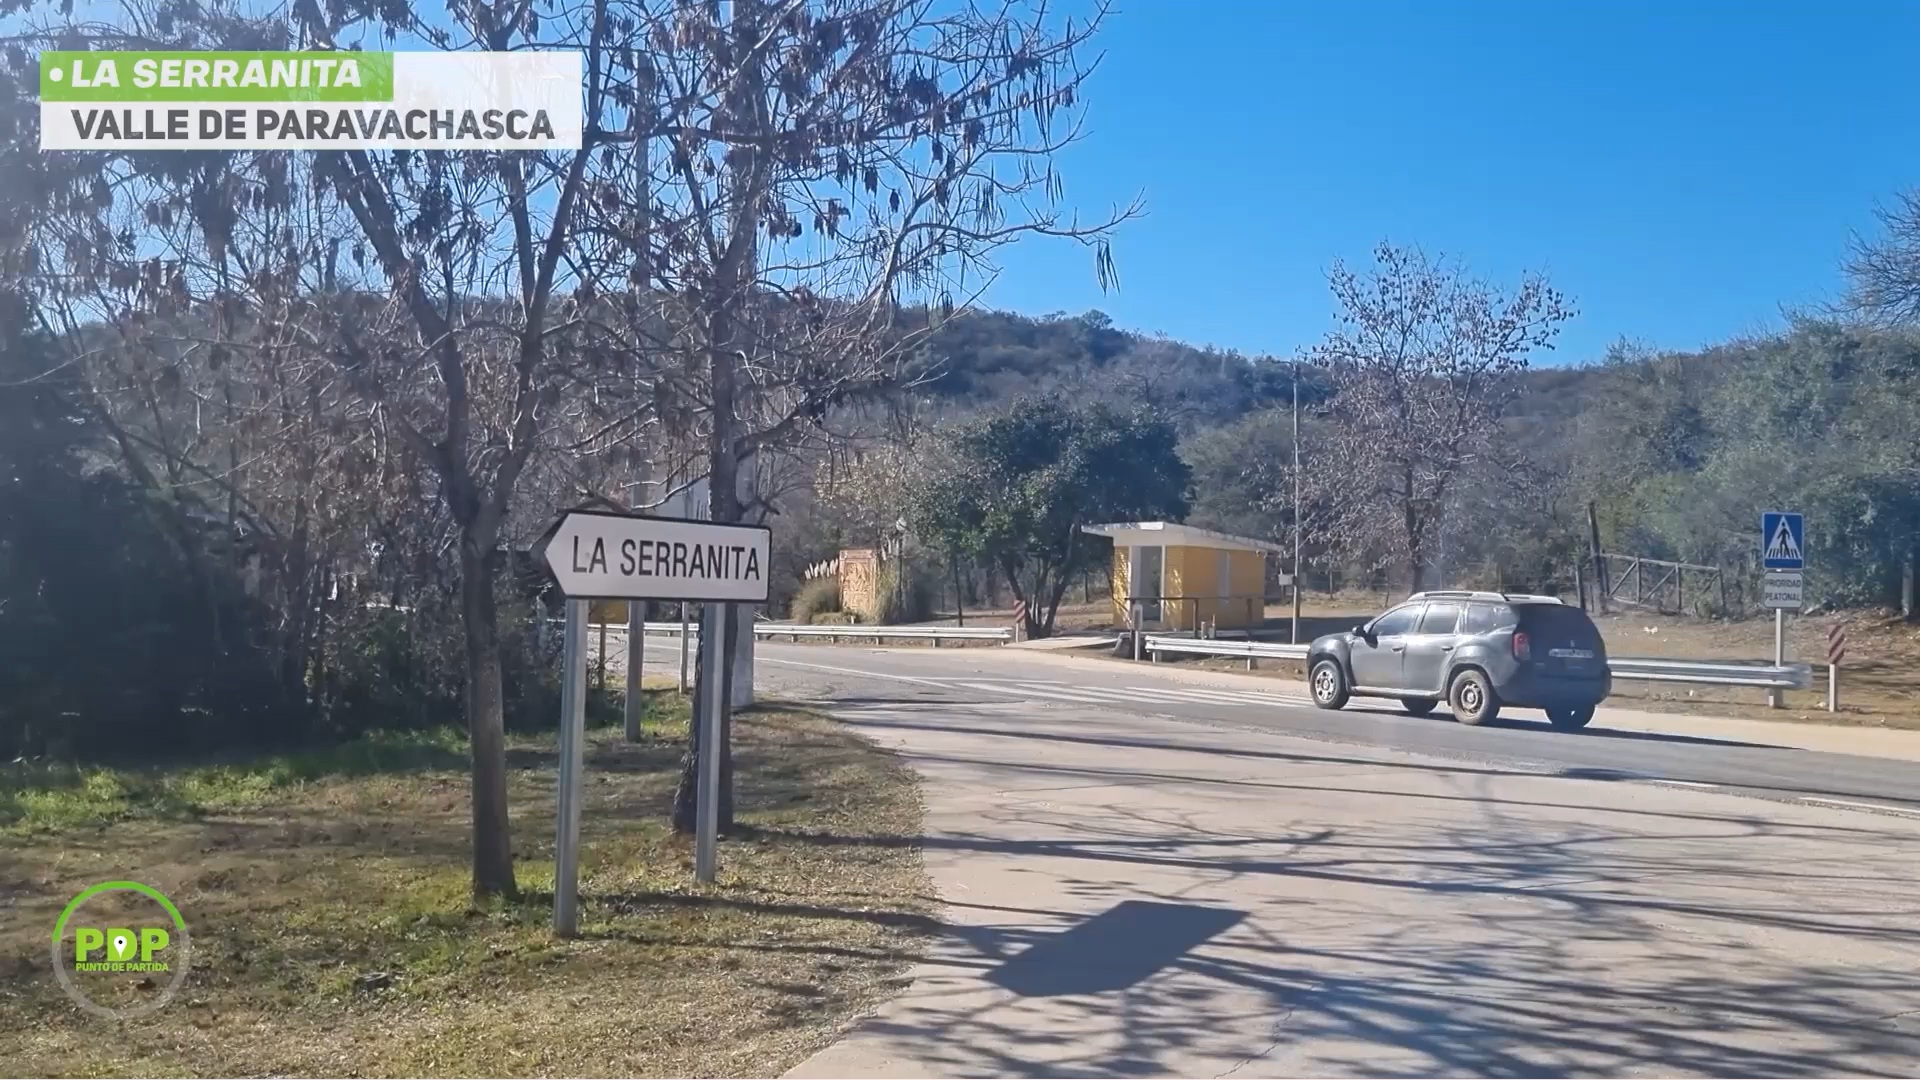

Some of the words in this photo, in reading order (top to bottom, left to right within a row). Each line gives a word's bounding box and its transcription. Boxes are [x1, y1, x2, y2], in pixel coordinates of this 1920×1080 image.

[572, 535, 608, 574] LA
[619, 538, 760, 581] SERRANITA
[1764, 578, 1801, 588] PRIORIDAD
